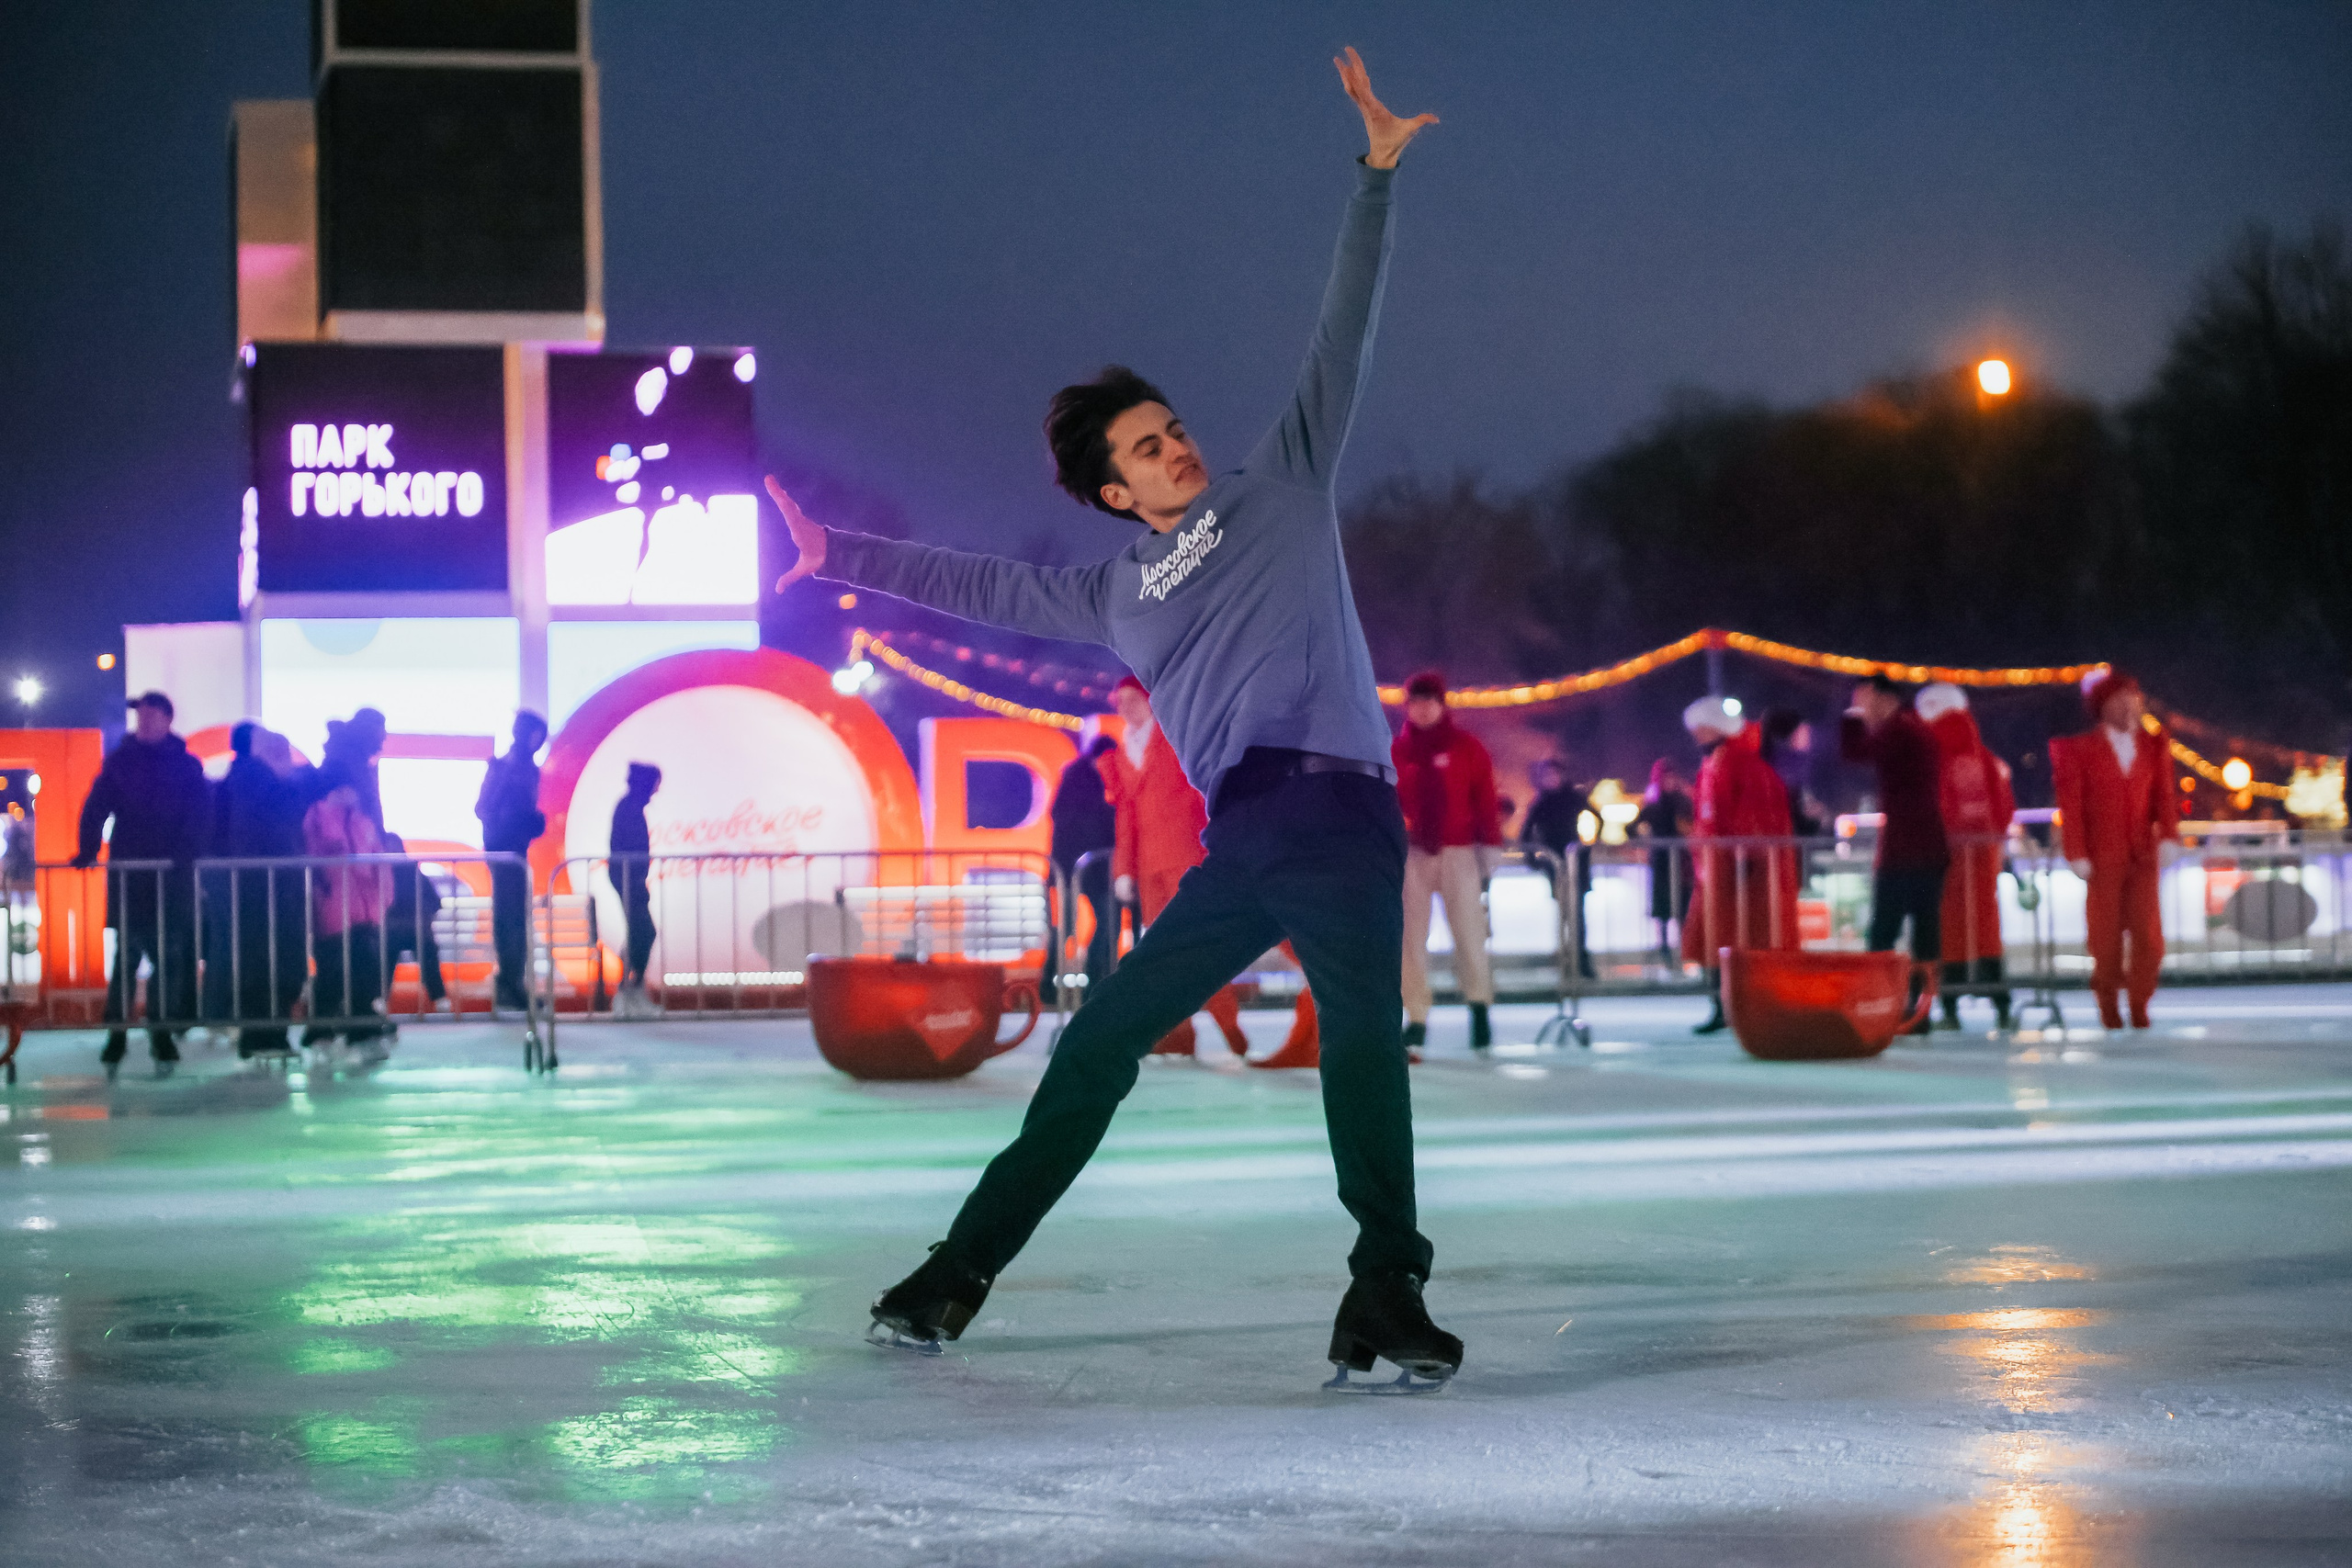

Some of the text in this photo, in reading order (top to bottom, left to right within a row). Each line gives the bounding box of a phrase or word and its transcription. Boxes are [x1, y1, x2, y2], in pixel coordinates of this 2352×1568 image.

[290, 423, 395, 468] ПАРК
[290, 470, 484, 517] ГОРЬКОГО
[1138, 509, 1217, 600] Московское
[647, 795, 824, 848] осковское
